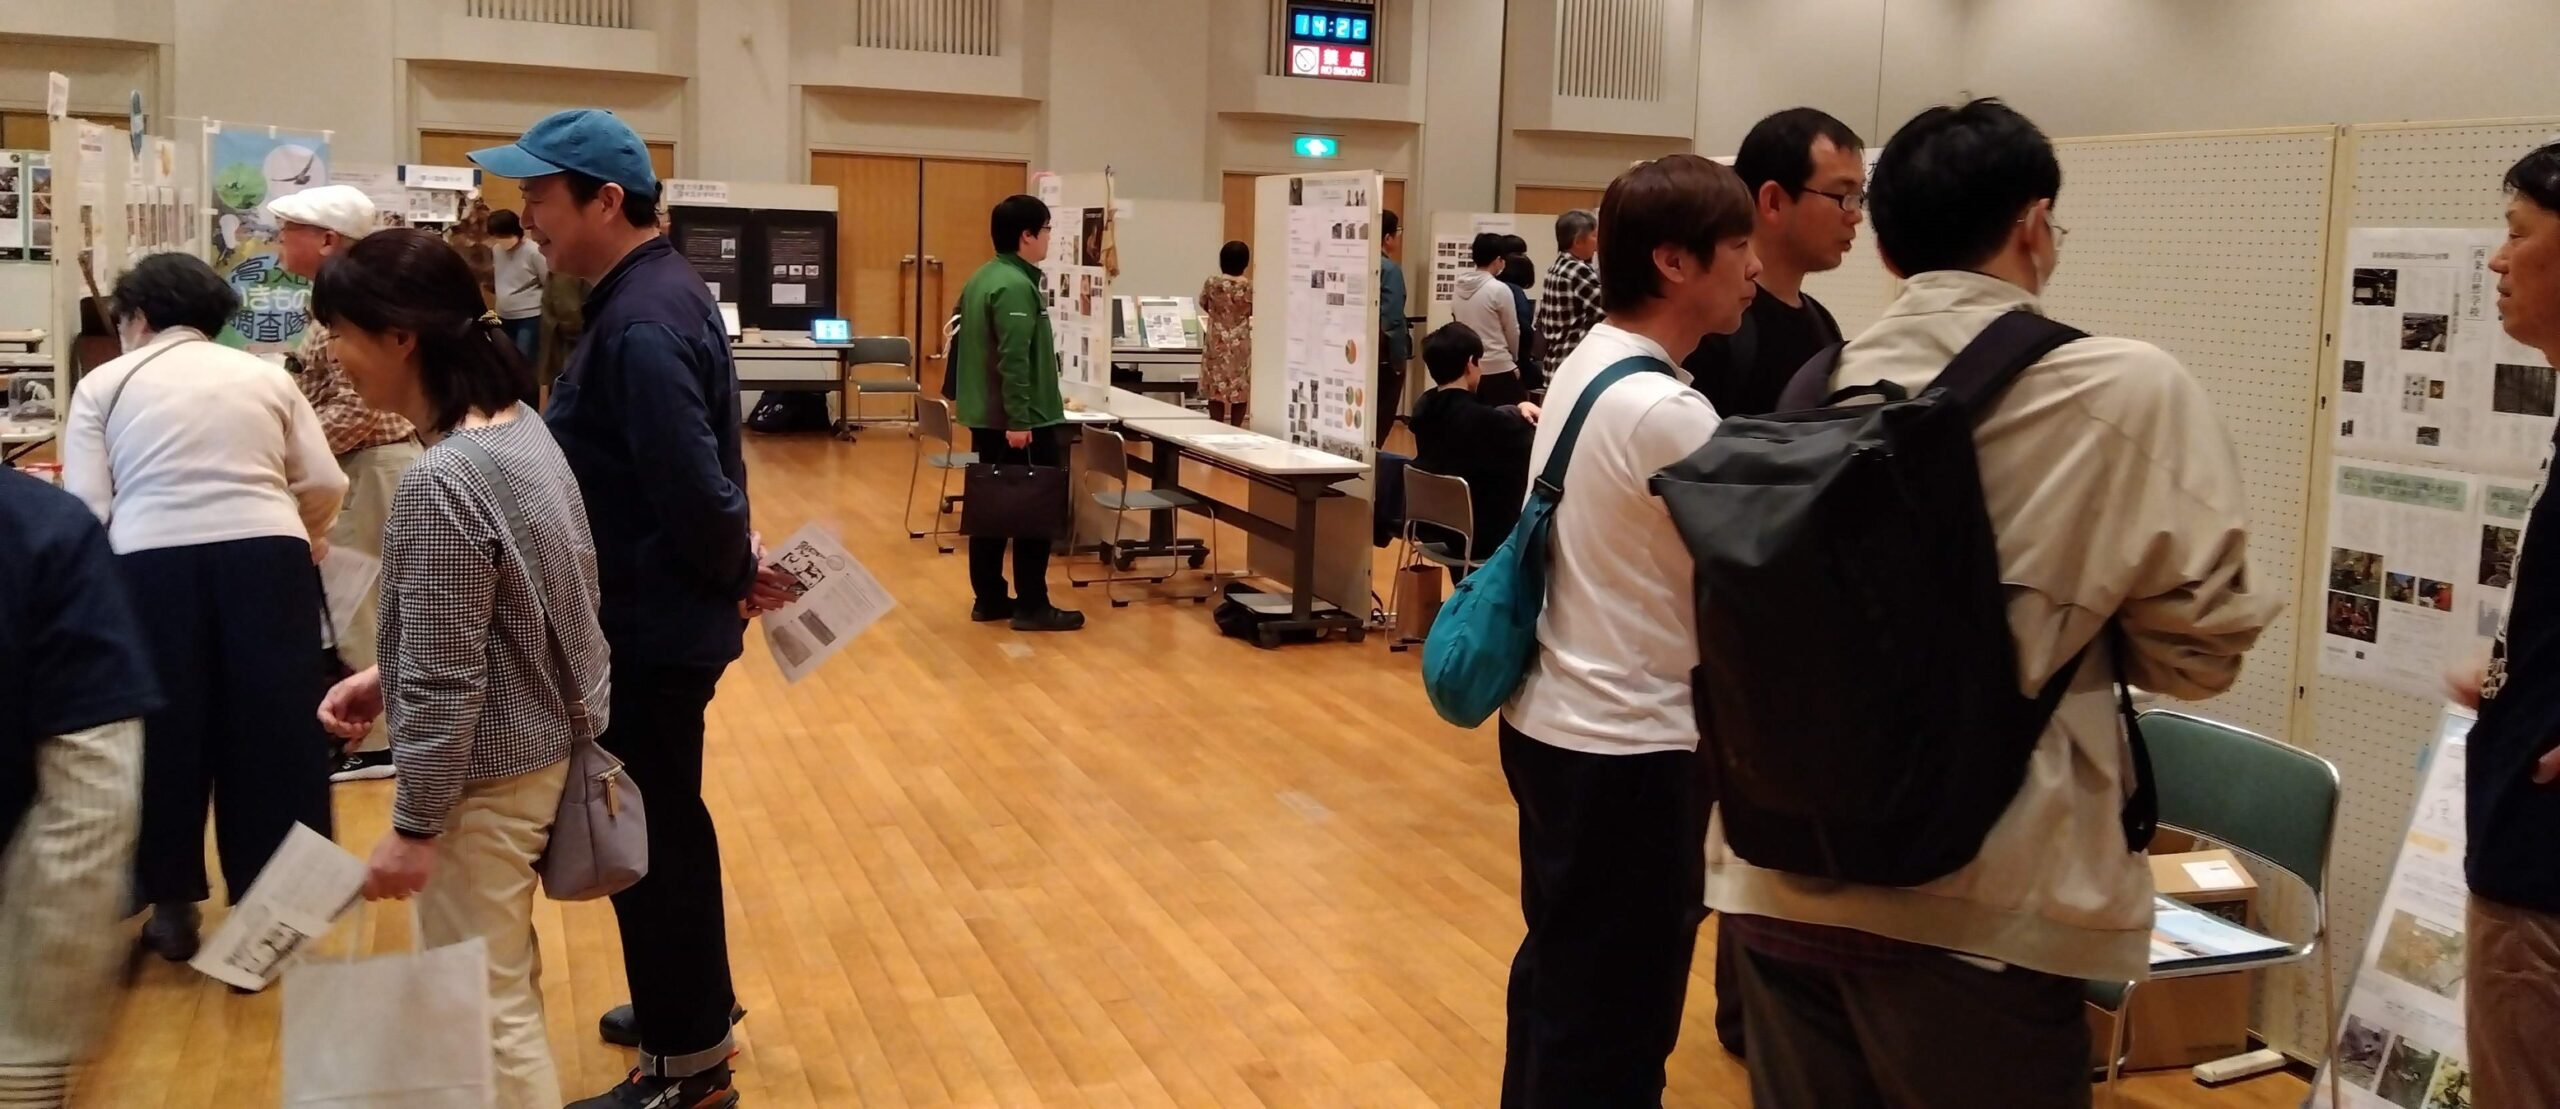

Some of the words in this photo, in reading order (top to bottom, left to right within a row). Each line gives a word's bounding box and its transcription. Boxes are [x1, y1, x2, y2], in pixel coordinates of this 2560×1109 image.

[1296, 15, 1367, 39] 14:22
[229, 306, 308, 343] 調査隊
